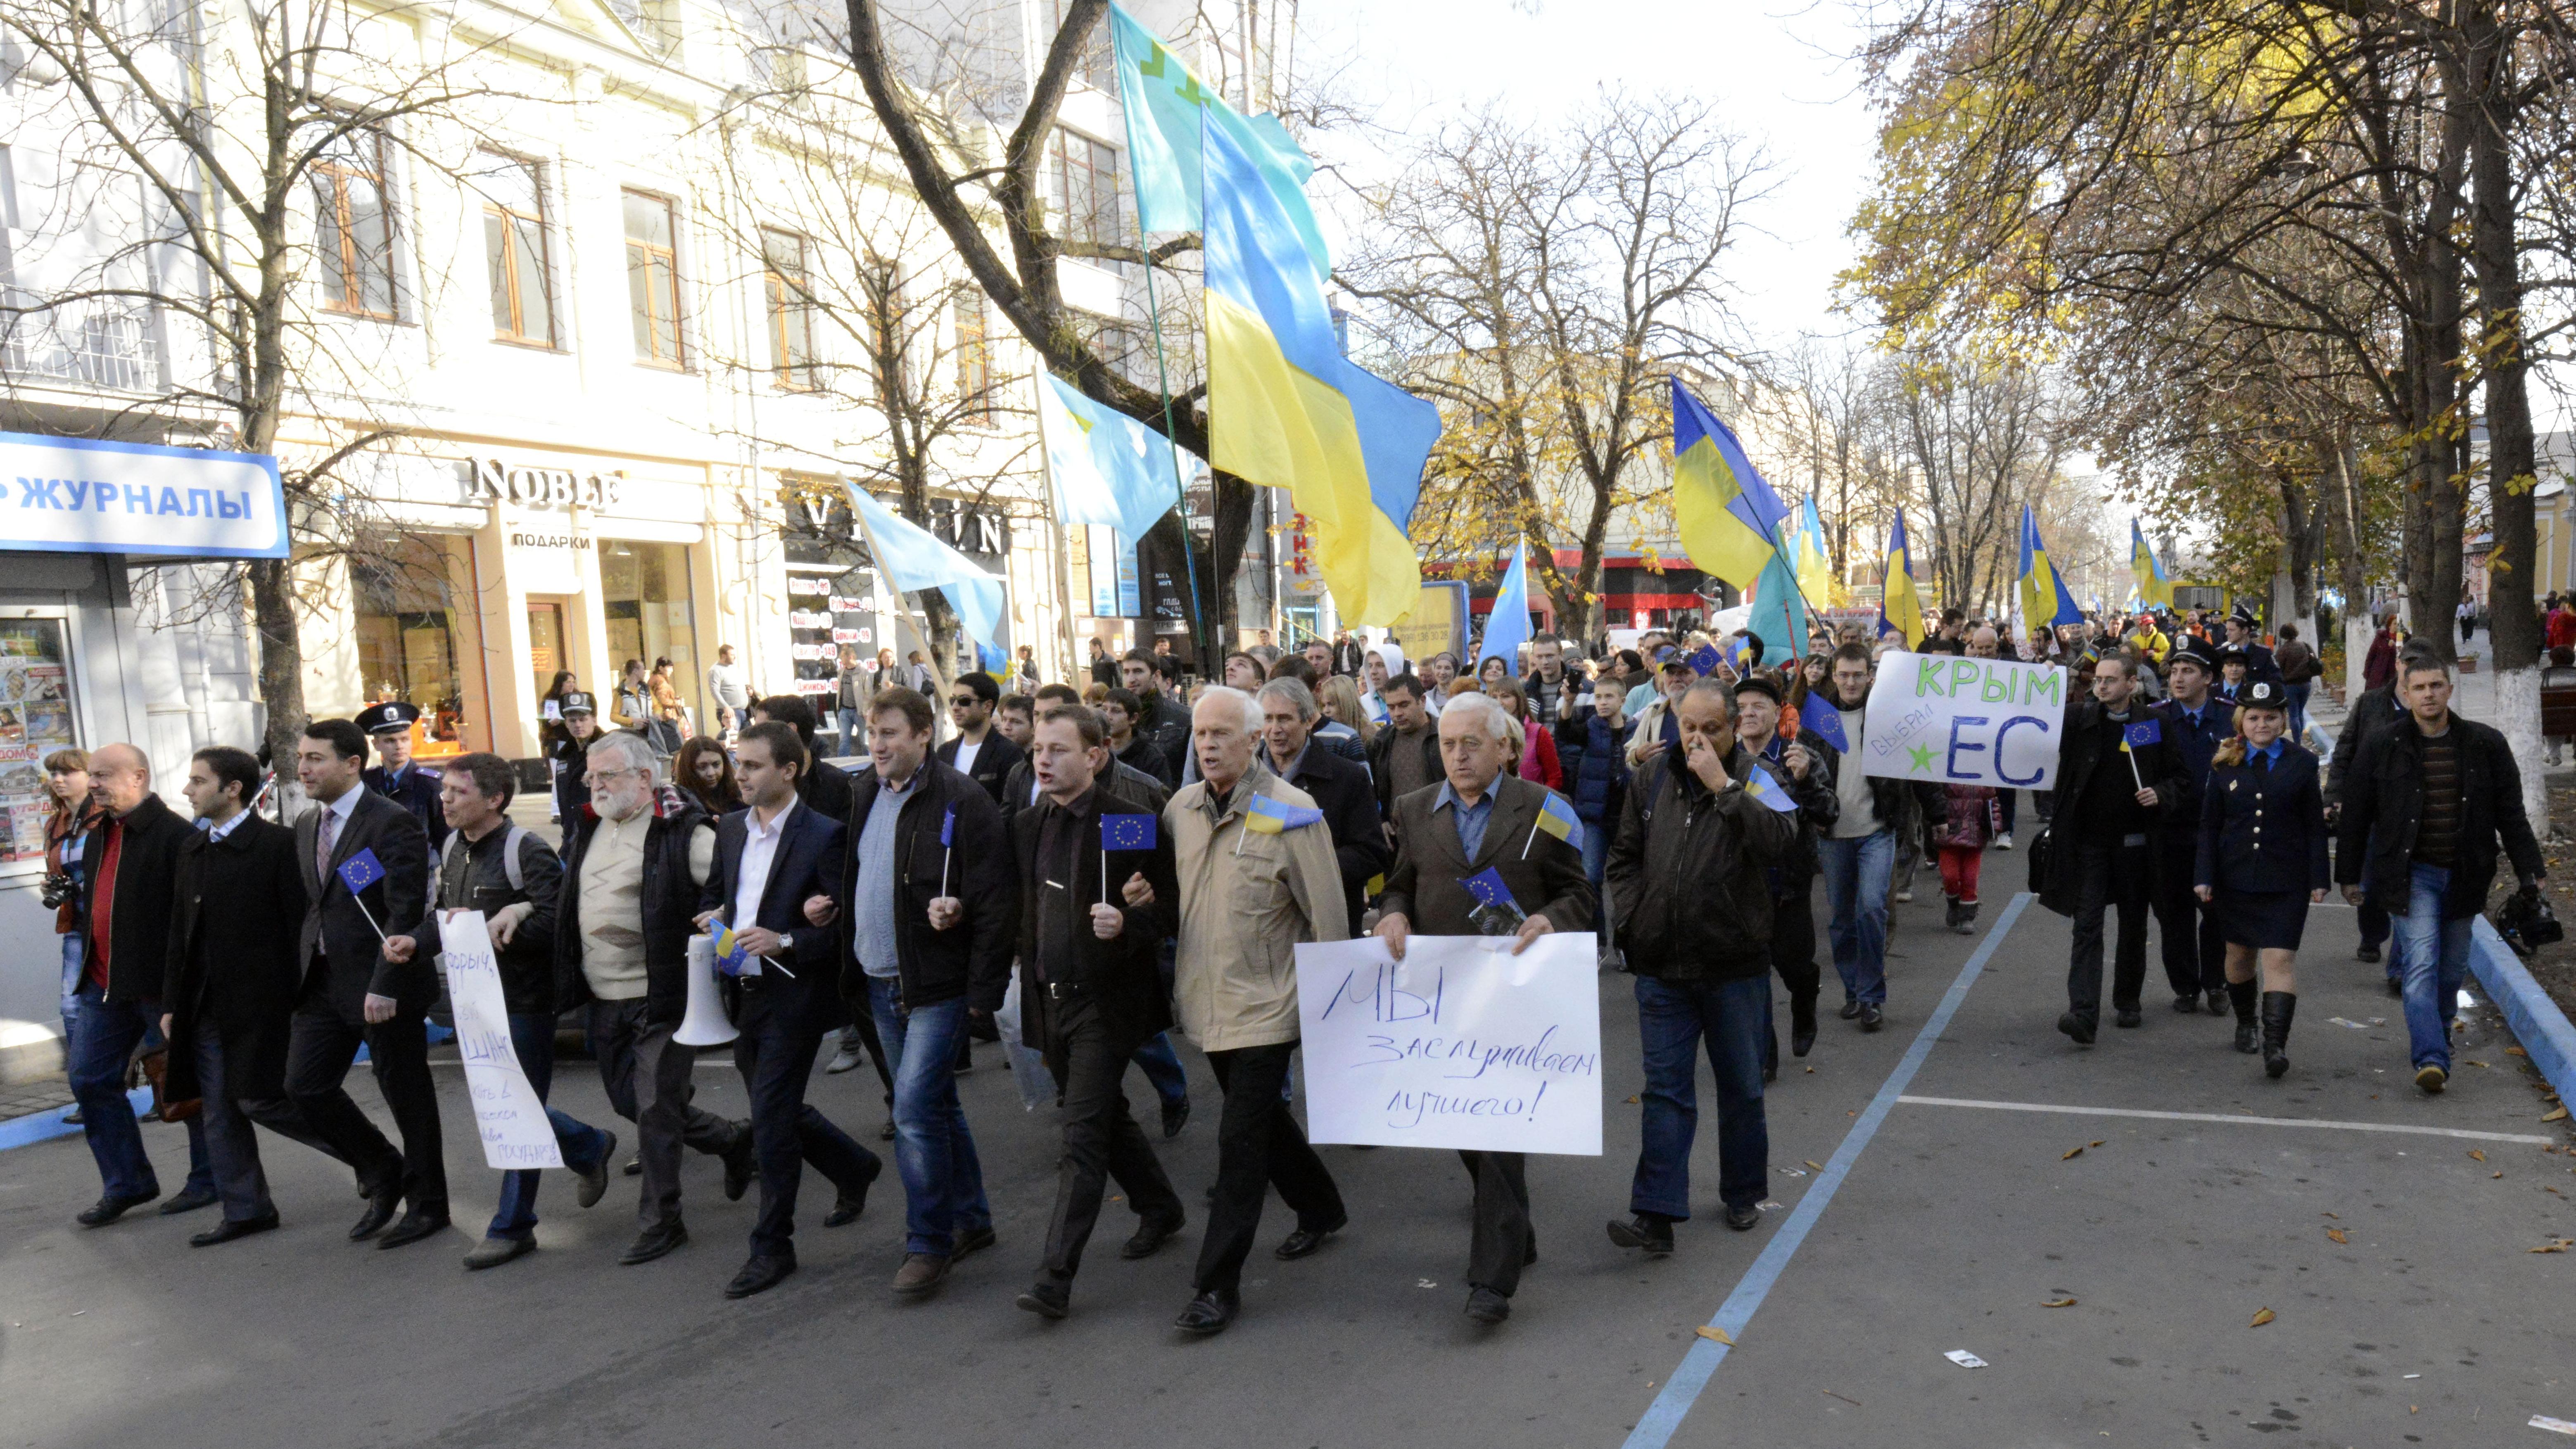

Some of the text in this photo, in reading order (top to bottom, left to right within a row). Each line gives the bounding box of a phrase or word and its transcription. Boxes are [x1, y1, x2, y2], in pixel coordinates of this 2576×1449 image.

[16, 476, 252, 520] ЖУРНАЛЫ
[466, 456, 622, 506] NOBLE
[513, 534, 590, 550] ПОДАРКИ
[824, 646, 836, 656] 149
[798, 682, 826, 692] Джинсы
[1916, 657, 2060, 707] КРЫМ
[1871, 704, 1933, 756] ВЫБРАЛ
[1947, 716, 2049, 785] ЕС
[1322, 963, 1443, 1024] МЫ
